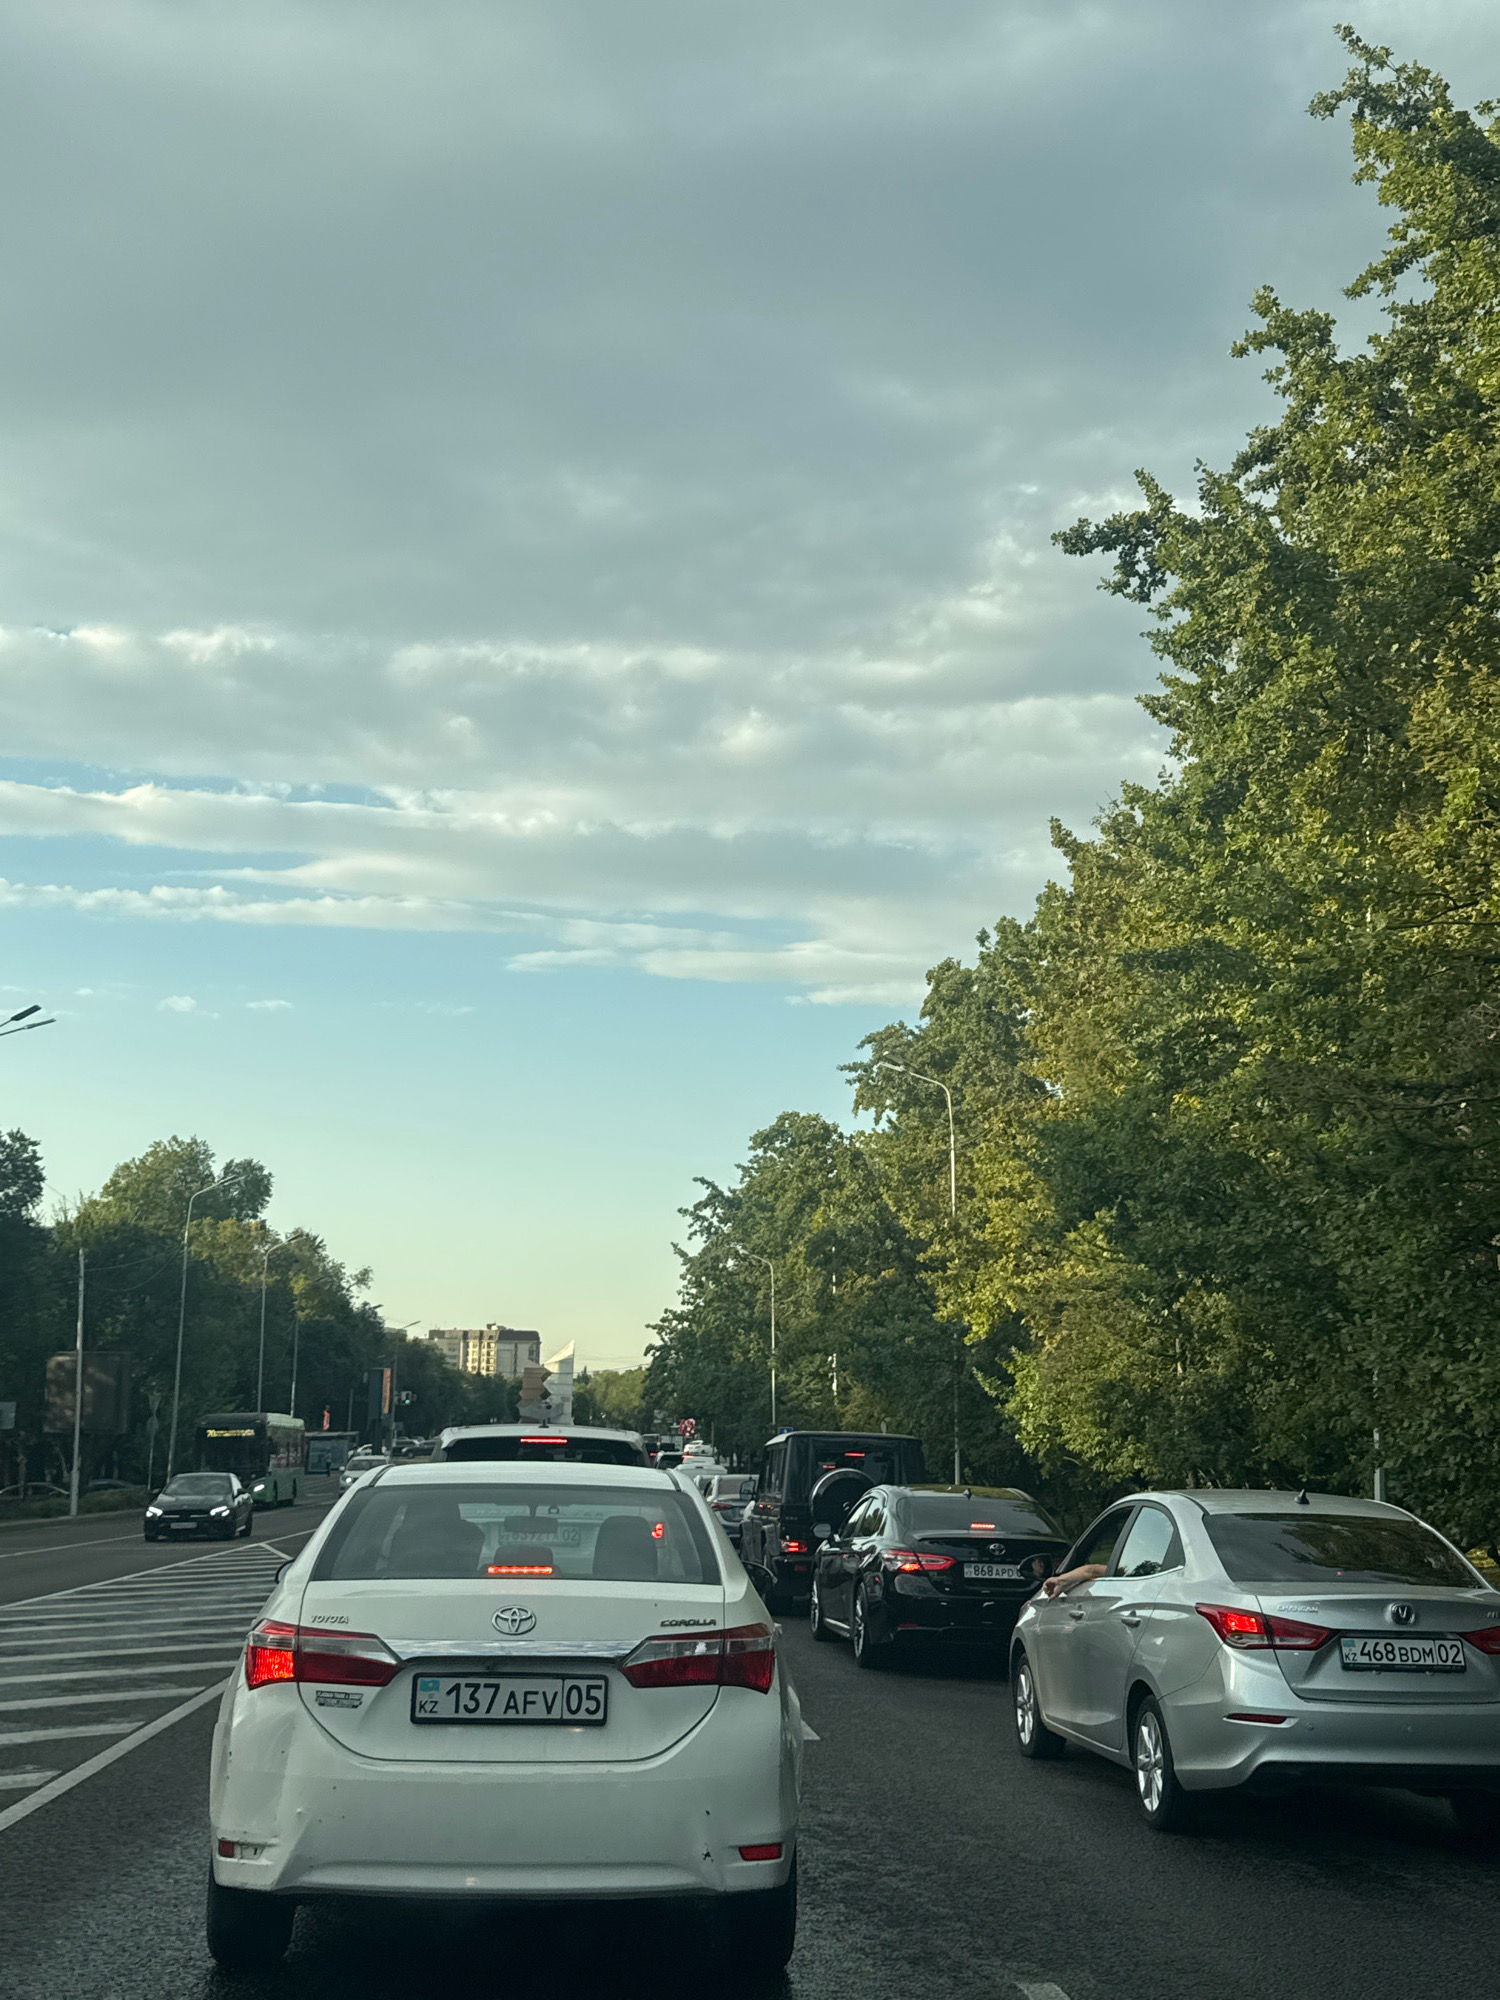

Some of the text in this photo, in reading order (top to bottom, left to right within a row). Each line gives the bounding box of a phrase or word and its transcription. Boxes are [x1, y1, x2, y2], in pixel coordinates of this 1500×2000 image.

[311, 1615, 349, 1625] TOYOTA
[659, 1618, 717, 1627] COROLLA
[1345, 1652, 1358, 1662] KZ
[418, 1700, 438, 1714] KZ
